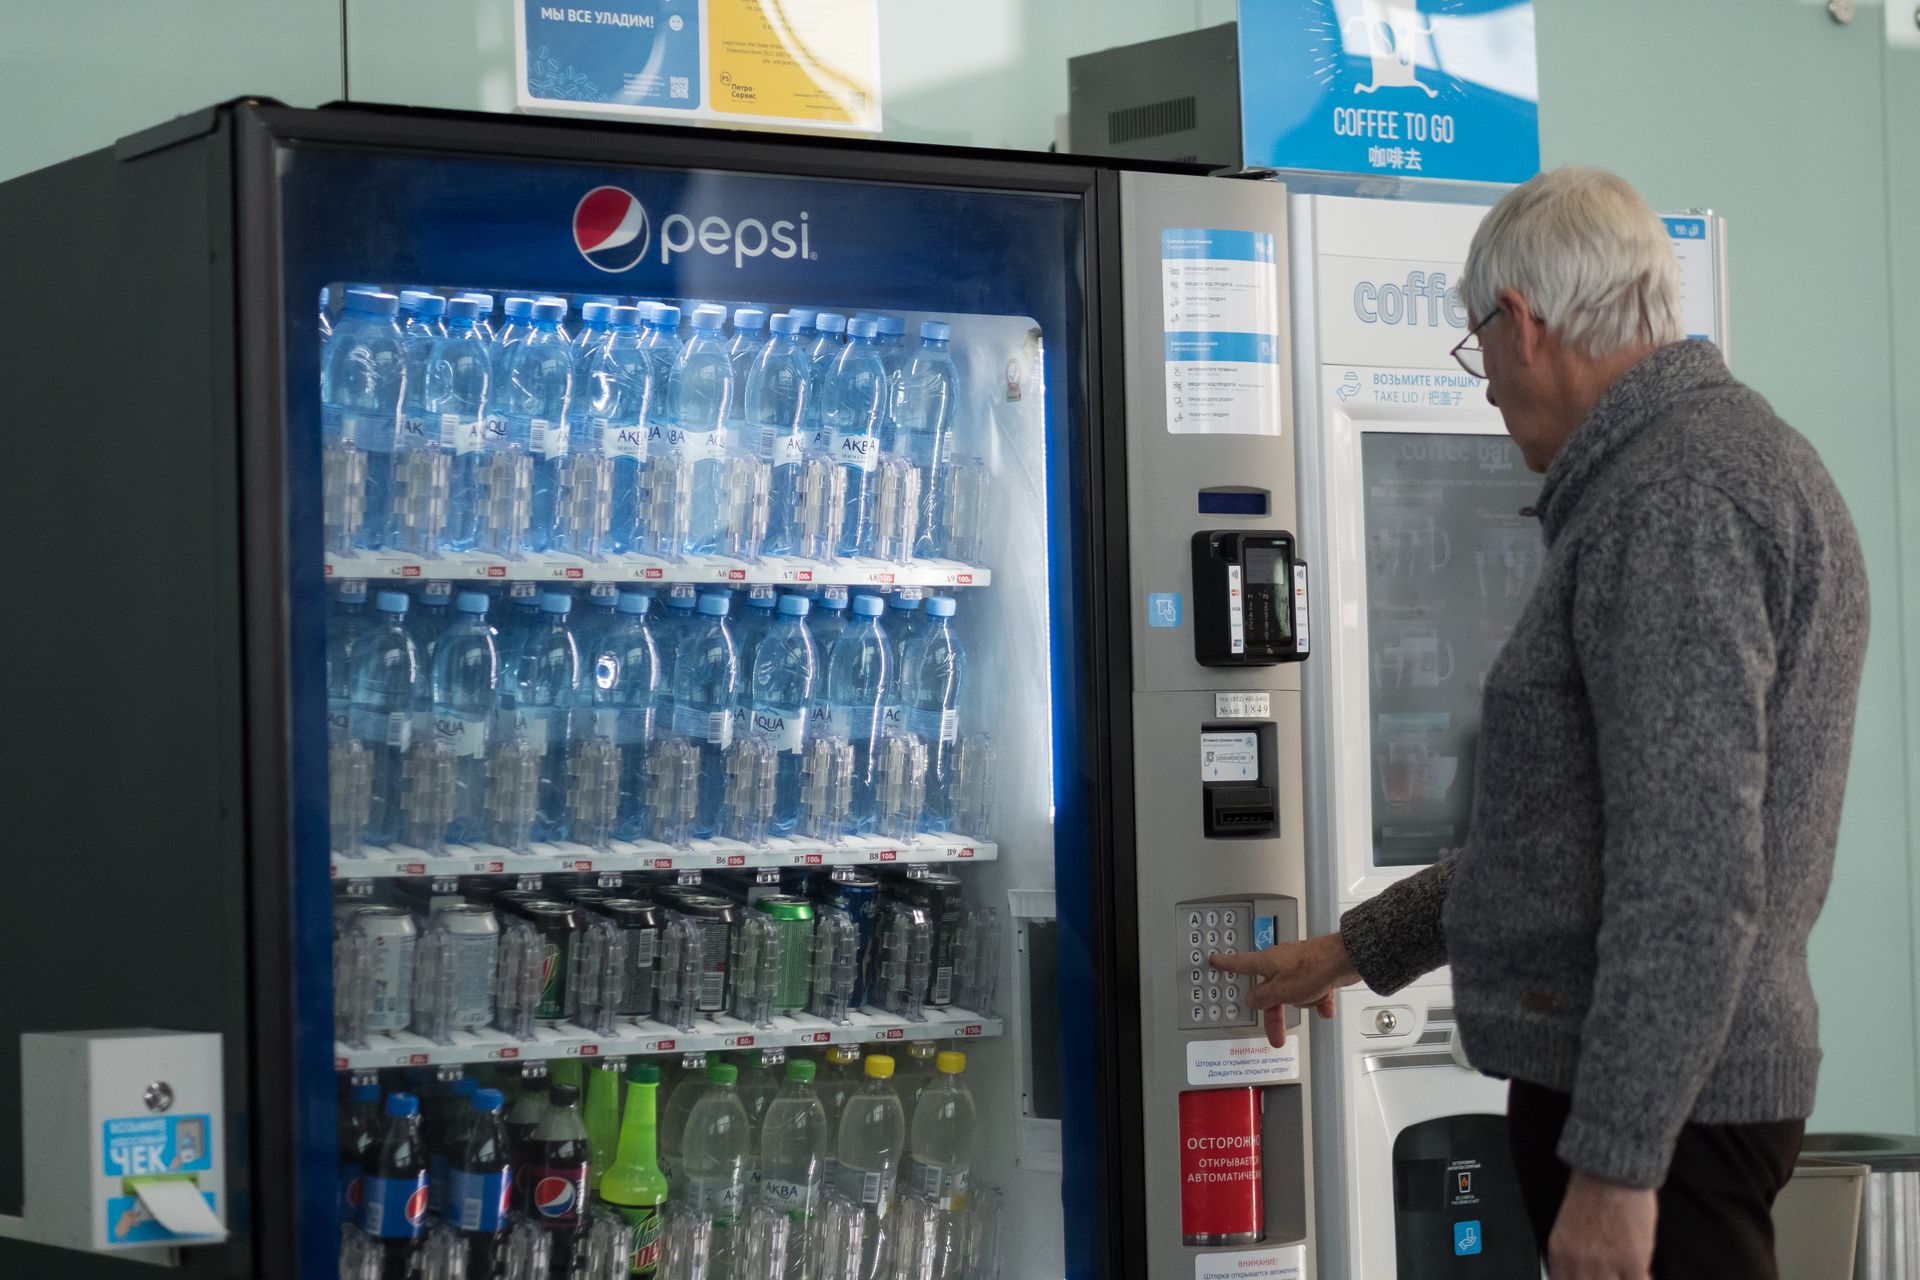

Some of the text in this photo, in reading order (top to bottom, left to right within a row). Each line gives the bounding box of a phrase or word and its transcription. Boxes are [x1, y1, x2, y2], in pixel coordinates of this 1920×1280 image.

[540, 7, 654, 28] МЫ ВСЕ УЛАДИМ!
[731, 91, 756, 99] Сервис
[1333, 107, 1455, 144] COFFEE TO GO
[1368, 146, 1423, 171] 咖啡去
[661, 211, 808, 268] pepsi
[1354, 271, 1467, 328] coffe
[1373, 373, 1481, 388] ВОЗЬМИТЕ КРЫШКУ
[1375, 391, 1400, 403] TAKE
[1402, 391, 1419, 404] LID
[841, 438, 876, 455] АКВА
[754, 712, 785, 732] AQUA
[869, 853, 879, 861] B8
[1191, 915, 1199, 924] A
[1227, 914, 1232, 923] 2
[1191, 933, 1233, 943] B 3 4
[1192, 952, 1200, 962] C
[1193, 971, 1200, 980] D
[1211, 970, 1216, 979] 7
[1193, 988, 1234, 999] E 9 0
[1194, 1008, 1200, 1017] F
[876, 1031, 886, 1039] C8
[955, 1028, 964, 1036] C9
[725, 1038, 735, 1046] C6
[1229, 1047, 1270, 1056] ВНИМАНИЕ!
[1195, 1060, 1221, 1068] Шторка
[1222, 1058, 1260, 1066] открывается
[1208, 1069, 1243, 1078] Дождитесь
[110, 1145, 167, 1176] ЧЕК
[764, 1181, 798, 1199] АКВА
[1238, 1258, 1278, 1268] ВНИМАНИЕ!
[1203, 1270, 1230, 1280] Шторка
